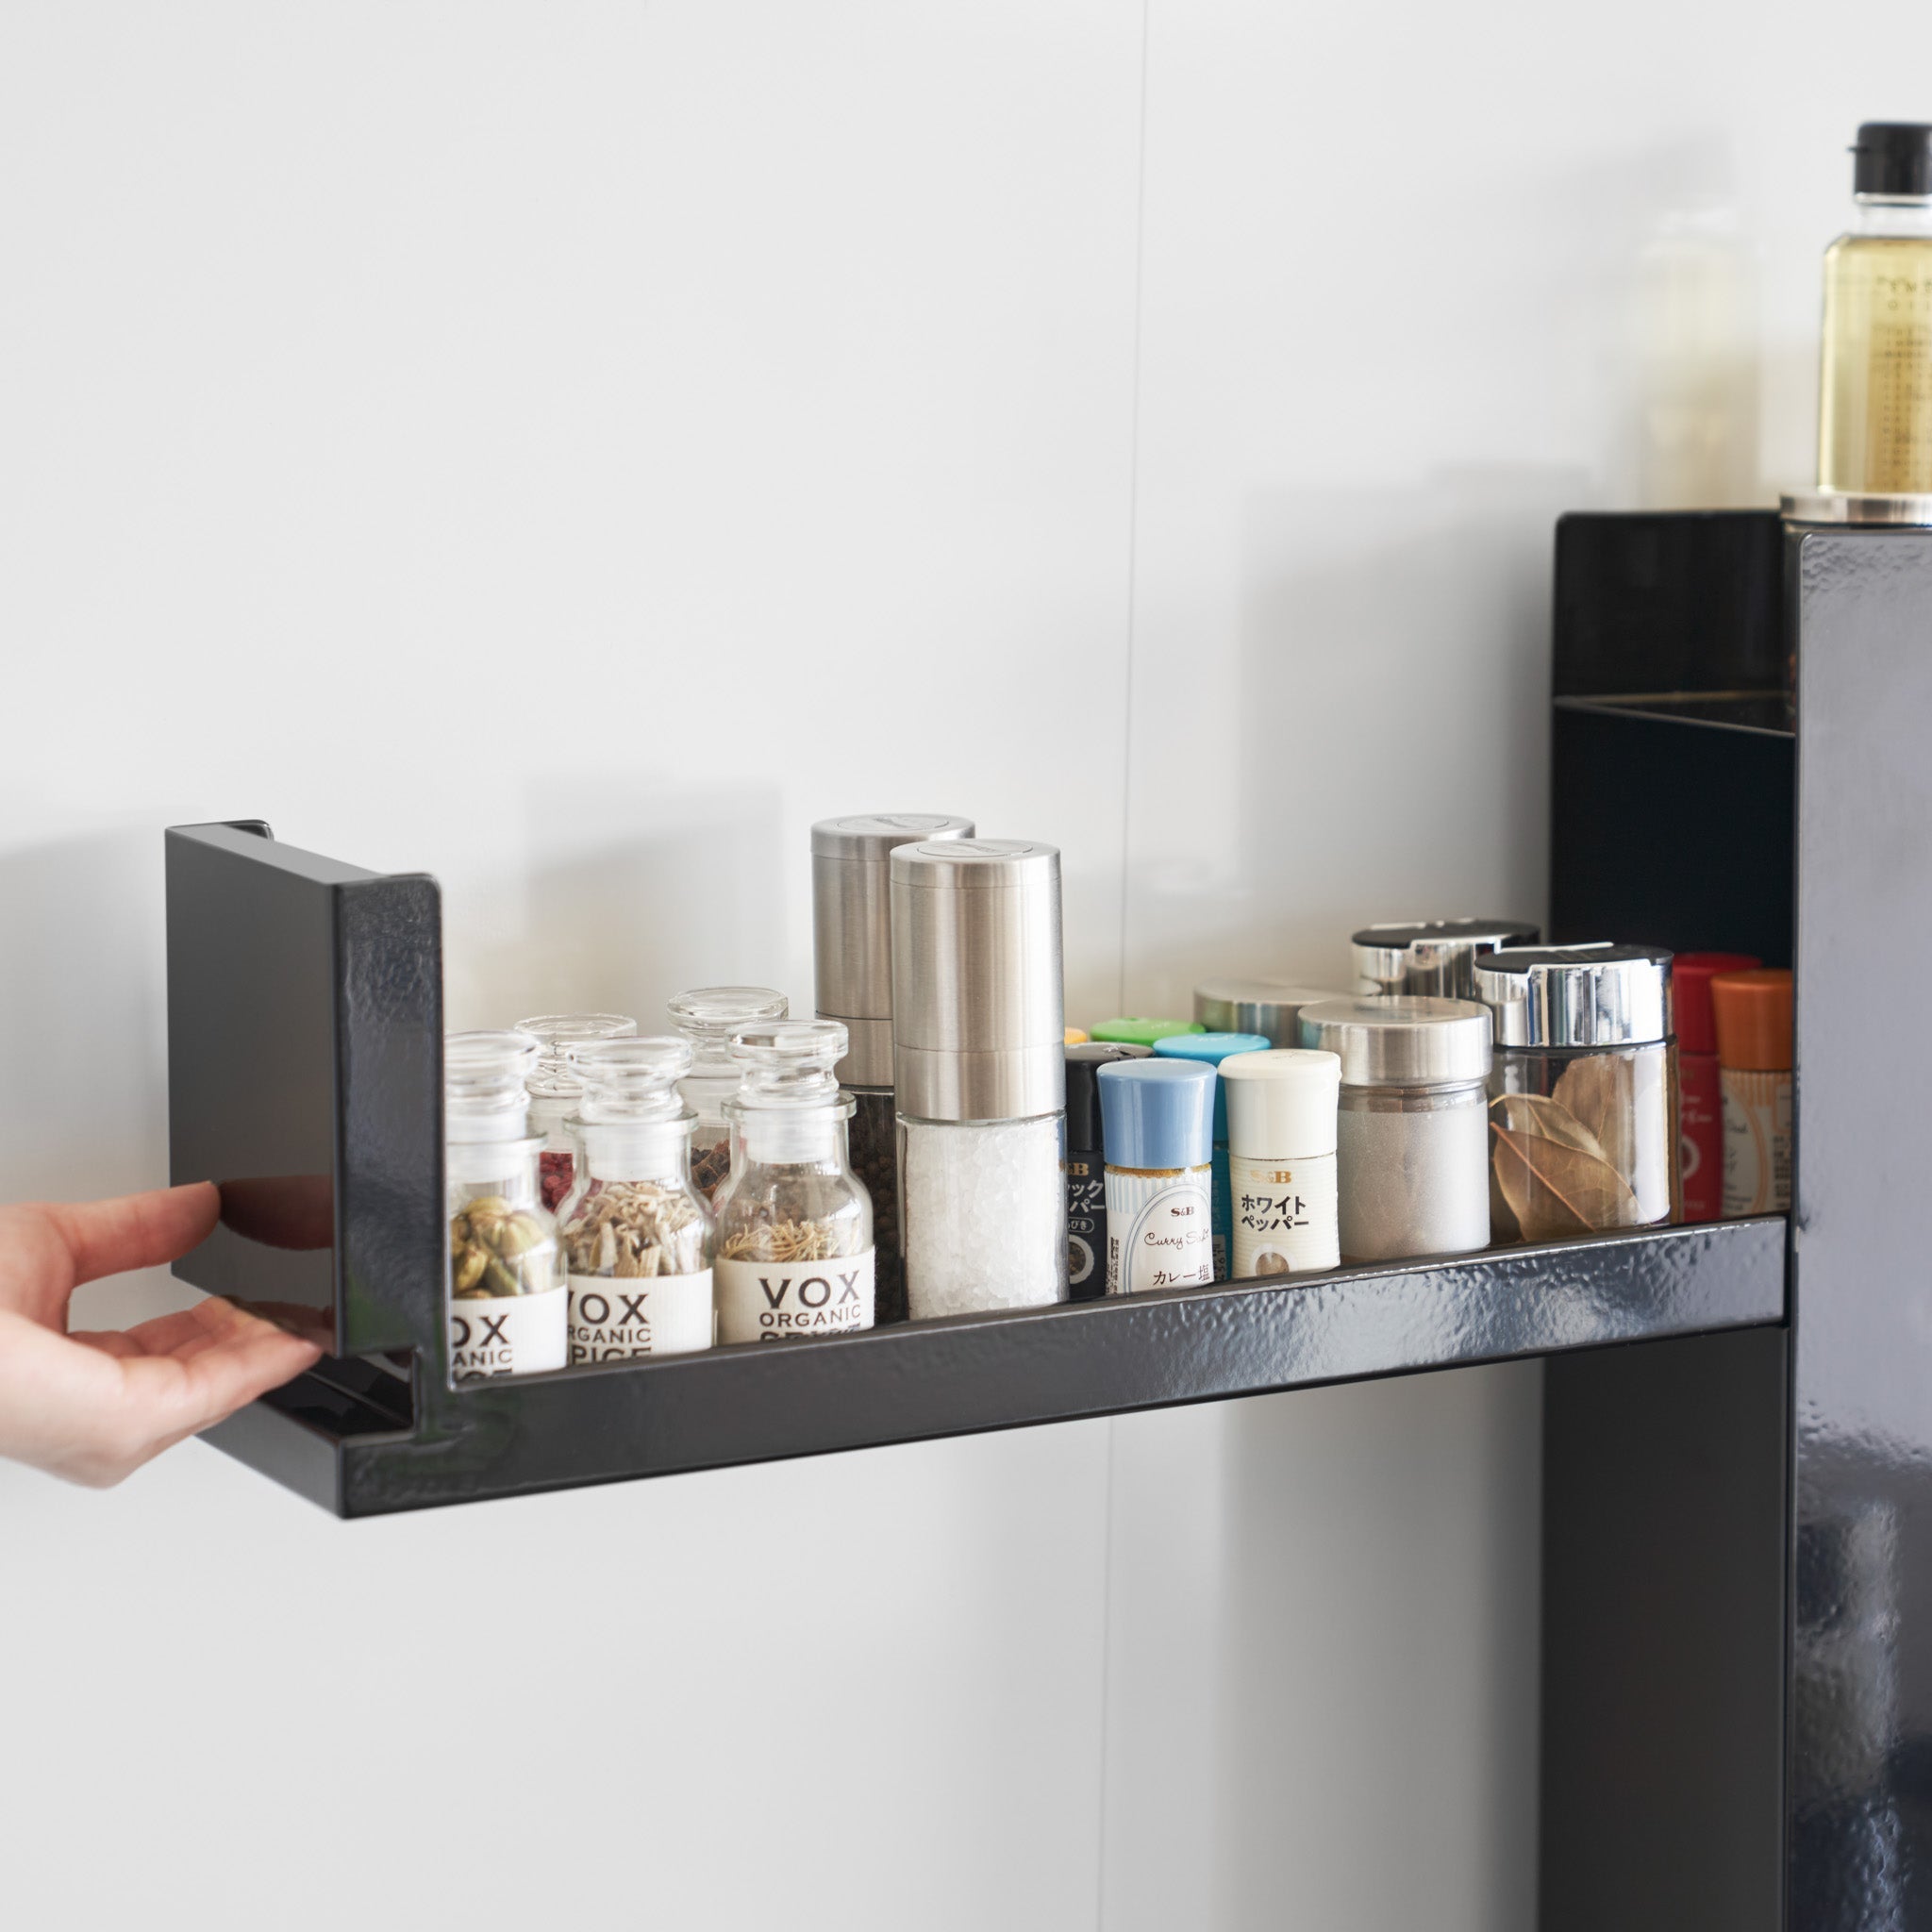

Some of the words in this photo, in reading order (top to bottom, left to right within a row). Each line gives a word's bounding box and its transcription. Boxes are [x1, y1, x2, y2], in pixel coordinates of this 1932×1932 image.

[1067, 1179, 1104, 1199] ック
[1069, 1198, 1106, 1213] パー
[1171, 1207, 1194, 1218] S&B
[1241, 1193, 1307, 1216] ホワイト
[1241, 1214, 1309, 1232] ペッパー
[1143, 1232, 1184, 1250] Curry
[1153, 1264, 1210, 1286] カレー塩
[758, 1269, 860, 1310] VOX
[759, 1304, 861, 1328] ORGANIC
[451, 1313, 510, 1349] OX
[568, 1324, 652, 1343] RGANIC
[452, 1348, 513, 1367] ANIC
